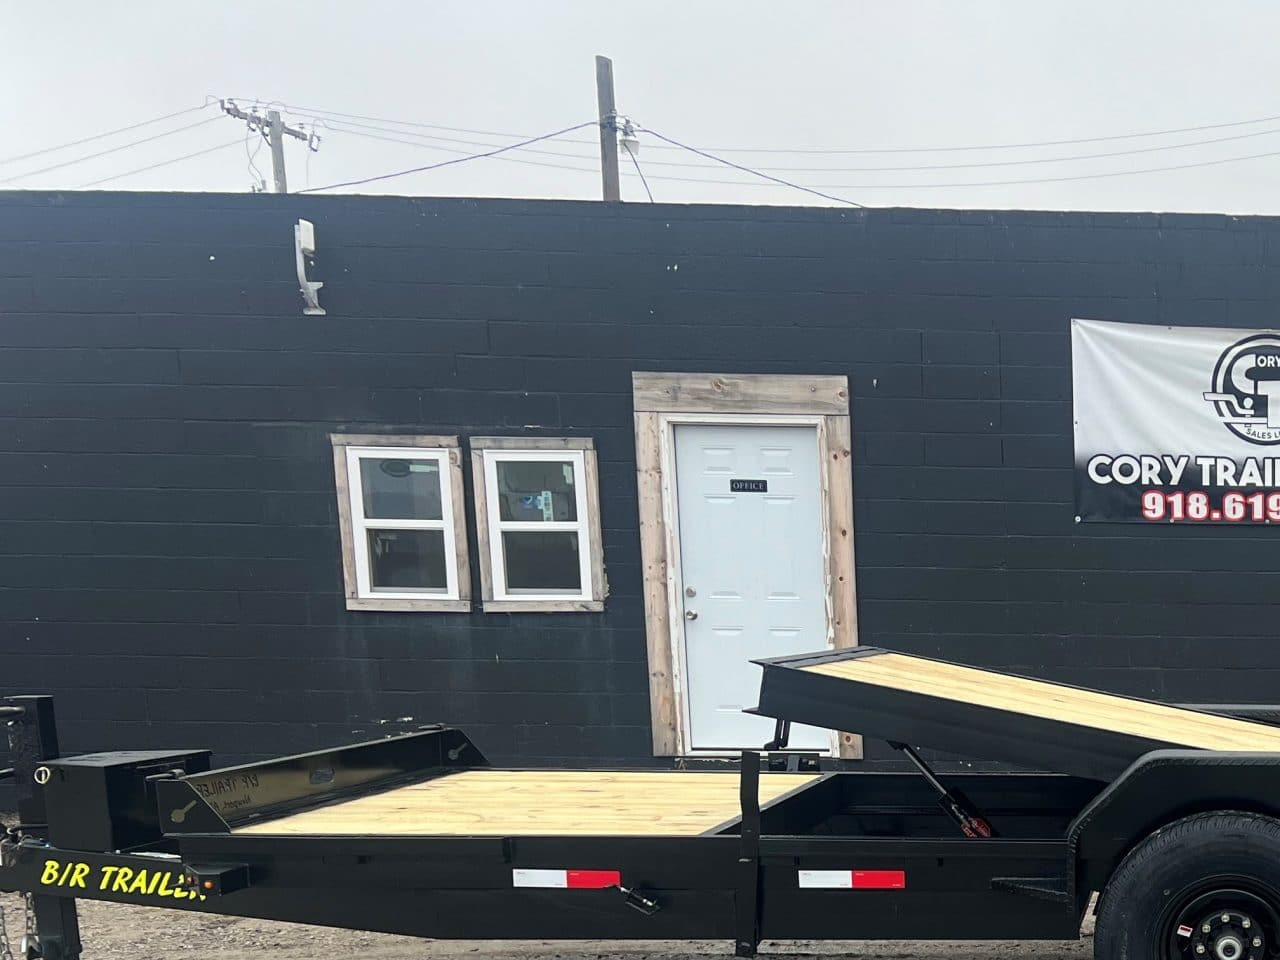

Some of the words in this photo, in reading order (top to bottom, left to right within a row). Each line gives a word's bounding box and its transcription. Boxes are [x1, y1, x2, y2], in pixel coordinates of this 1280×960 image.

[1246, 428, 1272, 440] SALES
[1087, 455, 1188, 485] CORY
[40, 859, 90, 888] B/R
[99, 866, 206, 901] TRAILE
